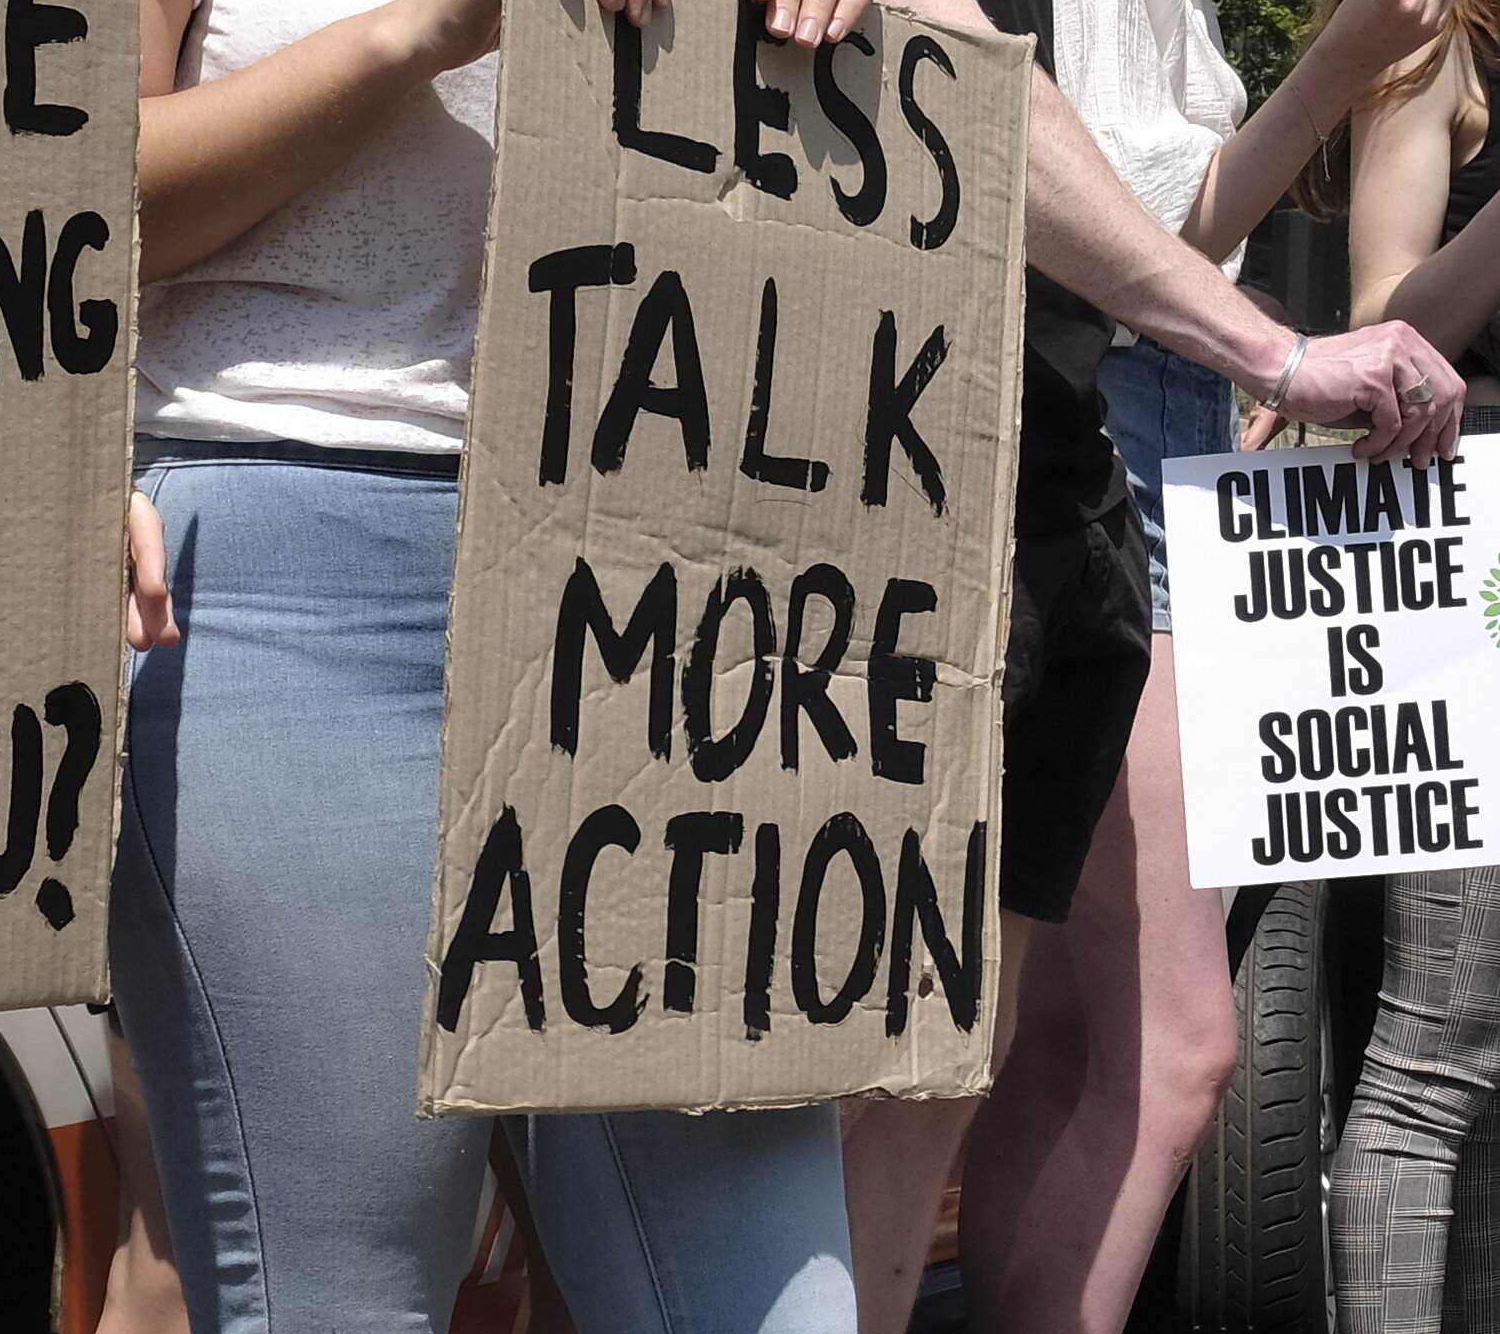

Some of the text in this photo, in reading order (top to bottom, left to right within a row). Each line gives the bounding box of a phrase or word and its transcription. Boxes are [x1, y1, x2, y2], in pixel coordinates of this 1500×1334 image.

[528, 241, 953, 517] TALK
[1216, 456, 1471, 543] CLIMATE
[1234, 537, 1468, 623] JUSTICE
[550, 556, 937, 784] MORE
[1326, 624, 1383, 697] IS
[1258, 700, 1464, 784] SOCIAL
[1251, 779, 1484, 866] JUSTICE
[437, 801, 987, 1042] ACTION
